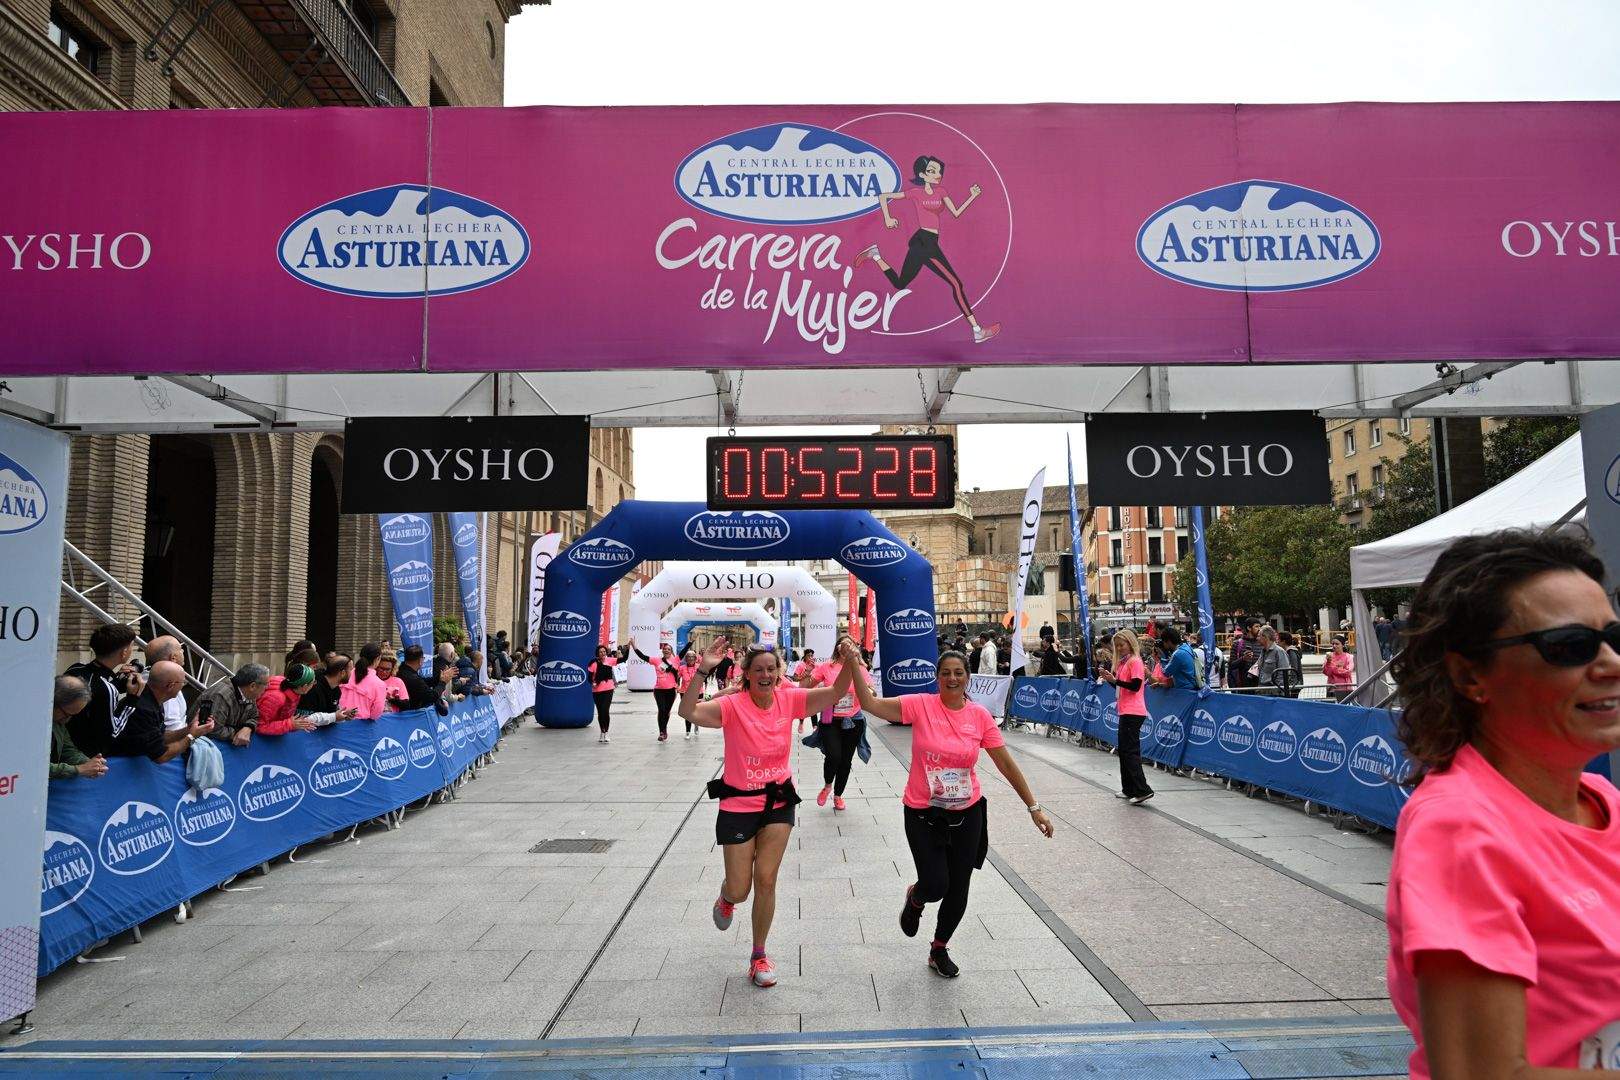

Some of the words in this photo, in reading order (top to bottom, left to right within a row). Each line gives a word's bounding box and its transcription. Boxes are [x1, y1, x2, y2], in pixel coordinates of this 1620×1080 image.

[727, 158, 798, 168] CENTRAL
[805, 158, 876, 168] LECHERA
[692, 160, 883, 198] ASTURIANA
[337, 224, 415, 235] CENTRAL
[421, 223, 503, 233] LECHERA
[1192, 219, 1268, 230] CENTRAL
[1276, 218, 1353, 229] LECHERA
[296, 227, 511, 268] ASTURIANA
[654, 217, 841, 272] Carrera
[1156, 222, 1363, 263] ASTURIANA
[700, 274, 736, 311] de
[743, 270, 769, 311] la
[763, 266, 912, 355] Mujer
[383, 447, 554, 482] OYSHO
[1126, 443, 1294, 478] OYSHO
[692, 519, 782, 539] ASTURIANA
[572, 547, 630, 561] ASTURIANA
[846, 548, 903, 560] ASTURIANA
[692, 573, 775, 590] OYSHO
[888, 620, 933, 631] ASTURIANA
[1259, 733, 1293, 755] ASTURIANA
[1301, 740, 1342, 765] ASTURIANA
[746, 755, 761, 767] TU
[315, 765, 365, 791] ASTURIANA
[244, 783, 302, 814] ASTURIANA
[181, 805, 234, 837] ASTURIANA
[107, 825, 173, 866] ASTURIANA
